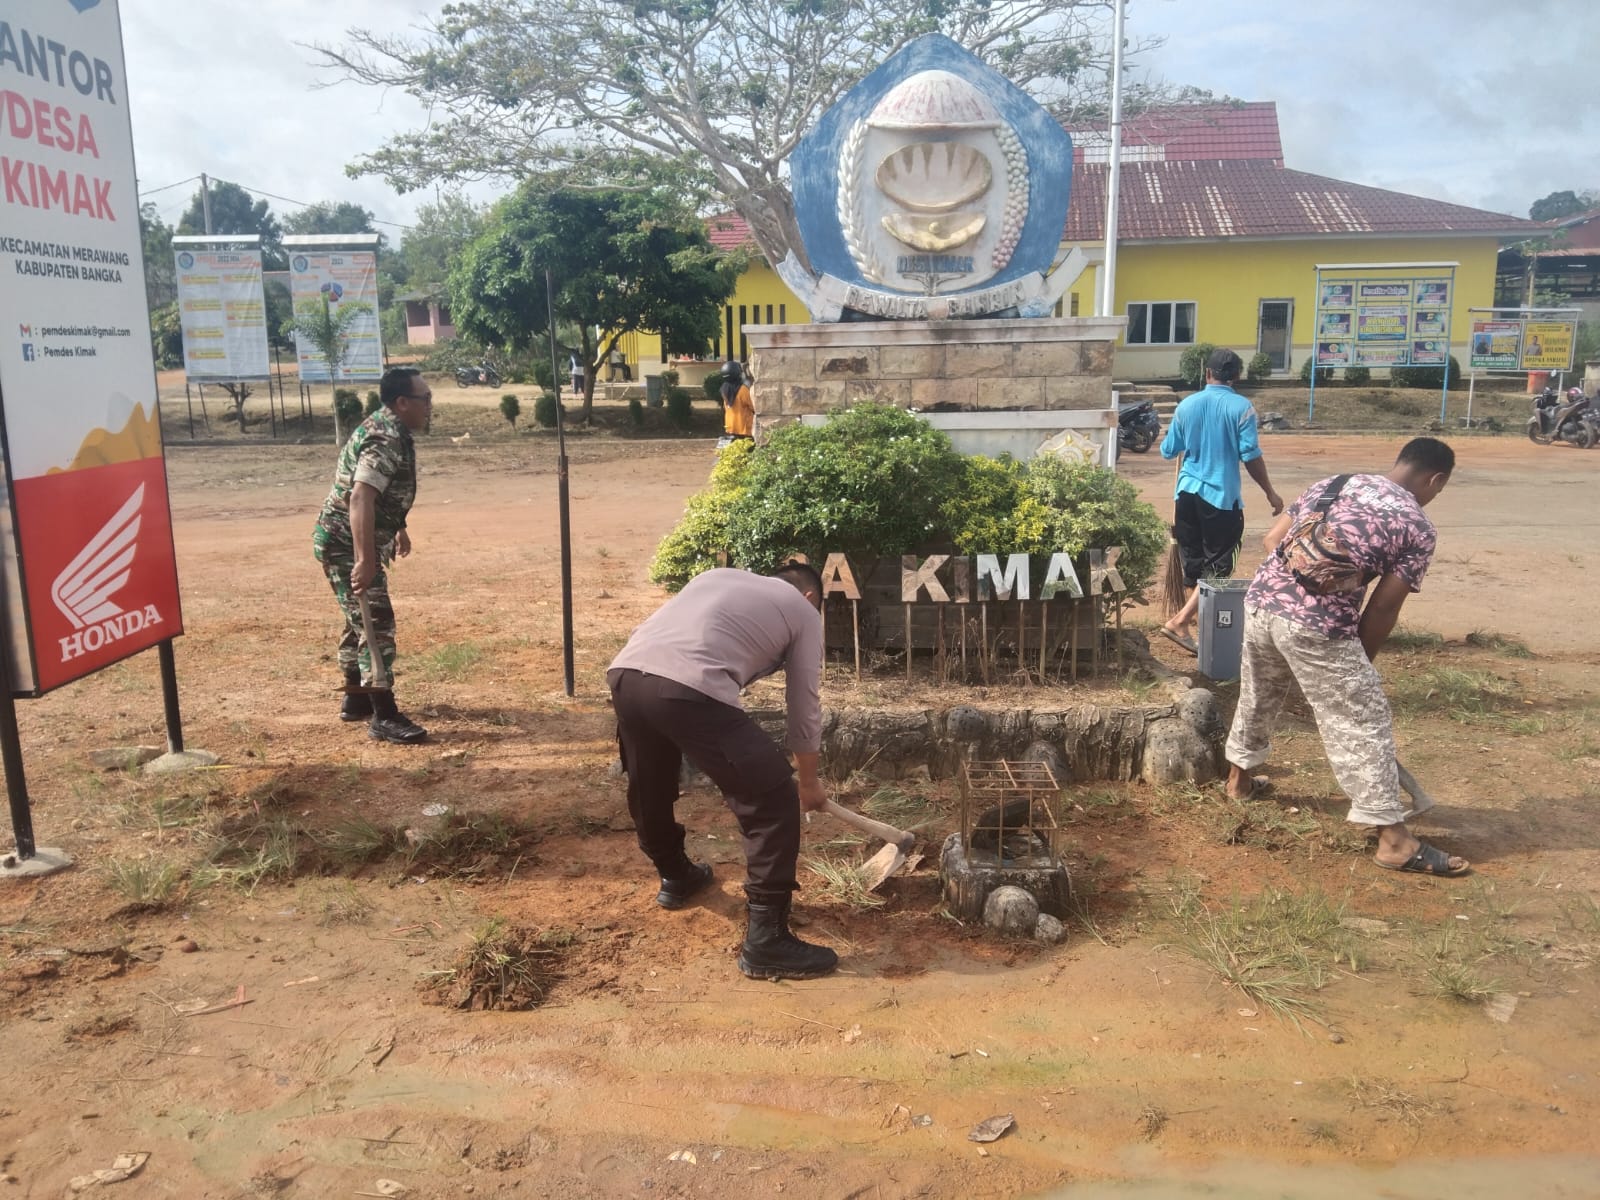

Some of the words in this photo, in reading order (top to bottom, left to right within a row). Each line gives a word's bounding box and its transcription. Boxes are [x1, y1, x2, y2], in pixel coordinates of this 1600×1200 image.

[0, 156, 116, 222] KIMAK
[0, 237, 70, 260] KECAMATAN
[72, 246, 129, 266] MERAWANG
[15, 259, 79, 280] KABUPATEN
[81, 266, 122, 283] BANGKA
[41, 325, 131, 339] pemdeskimak@gmail.com
[44, 346, 73, 358] Pemdes
[74, 346, 97, 357] Kimak
[901, 546, 1127, 604] KIMAK
[58, 604, 163, 663] HONDA
